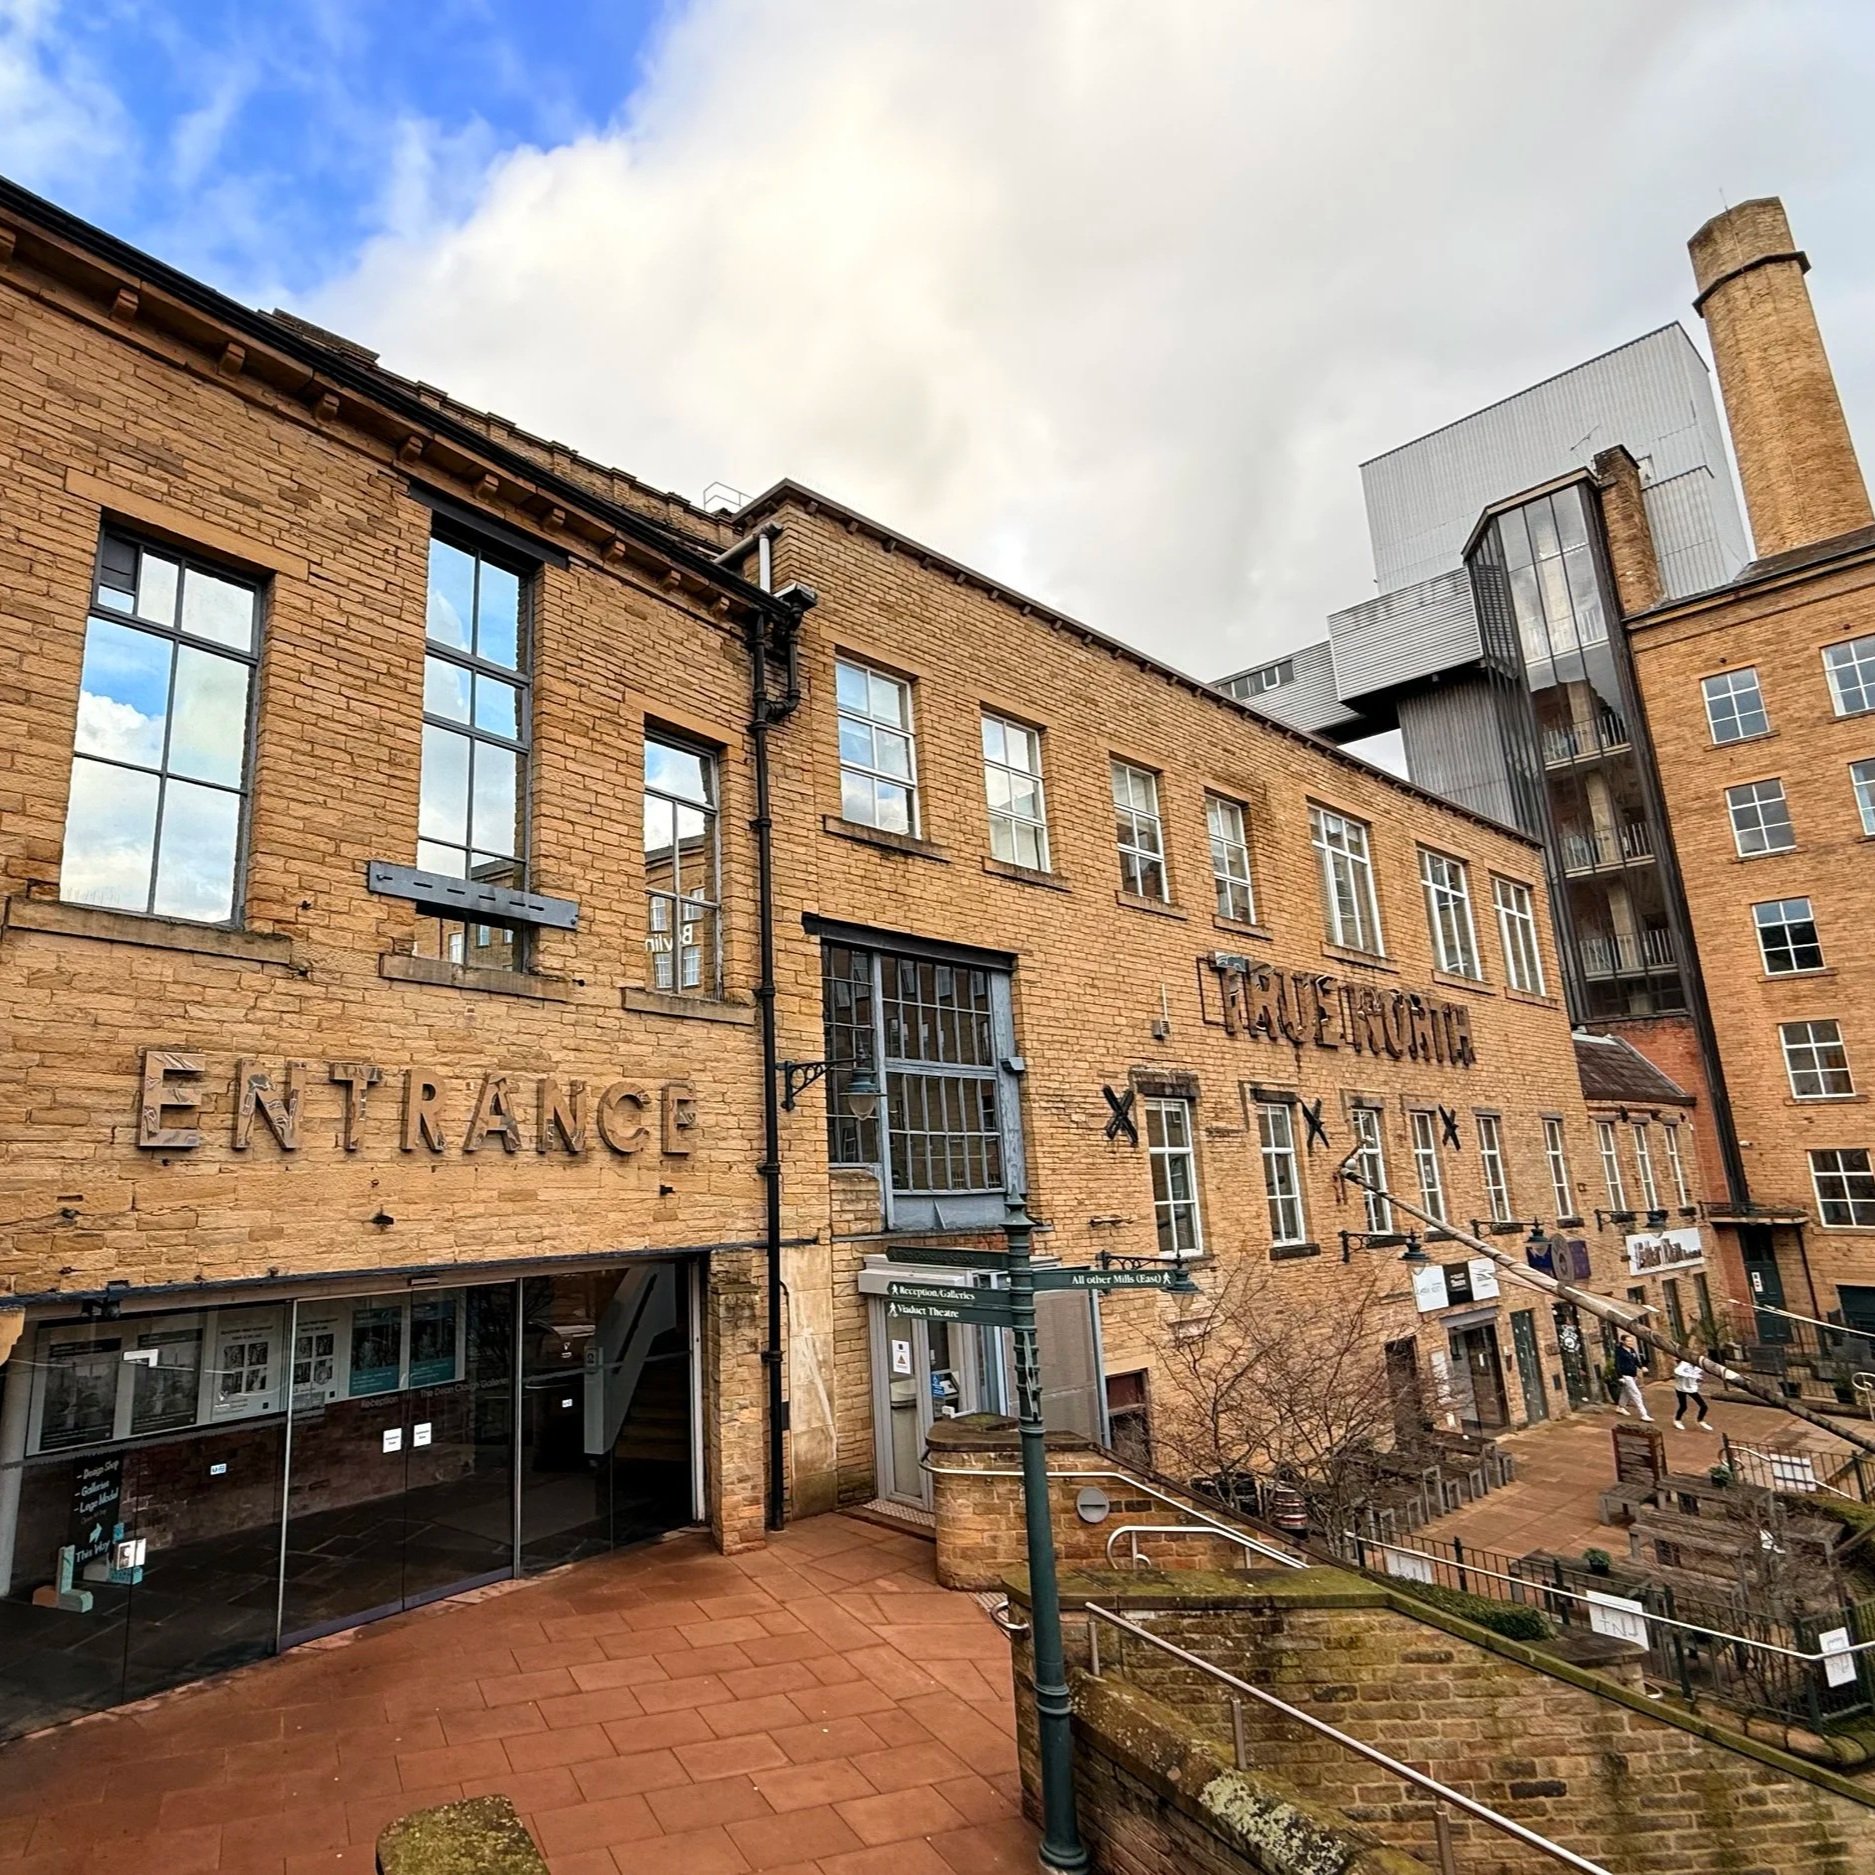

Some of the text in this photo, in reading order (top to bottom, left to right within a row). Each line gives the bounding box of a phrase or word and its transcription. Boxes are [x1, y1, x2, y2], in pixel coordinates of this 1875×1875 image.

[1208, 951, 1477, 1067] TRUE NORTH
[136, 1050, 698, 1155] ENTRANCE
[1072, 1274, 1162, 1285] All other Mills (East)
[897, 1304, 959, 1318] Viaduct Theatre
[75, 1539, 111, 1563] This Way
